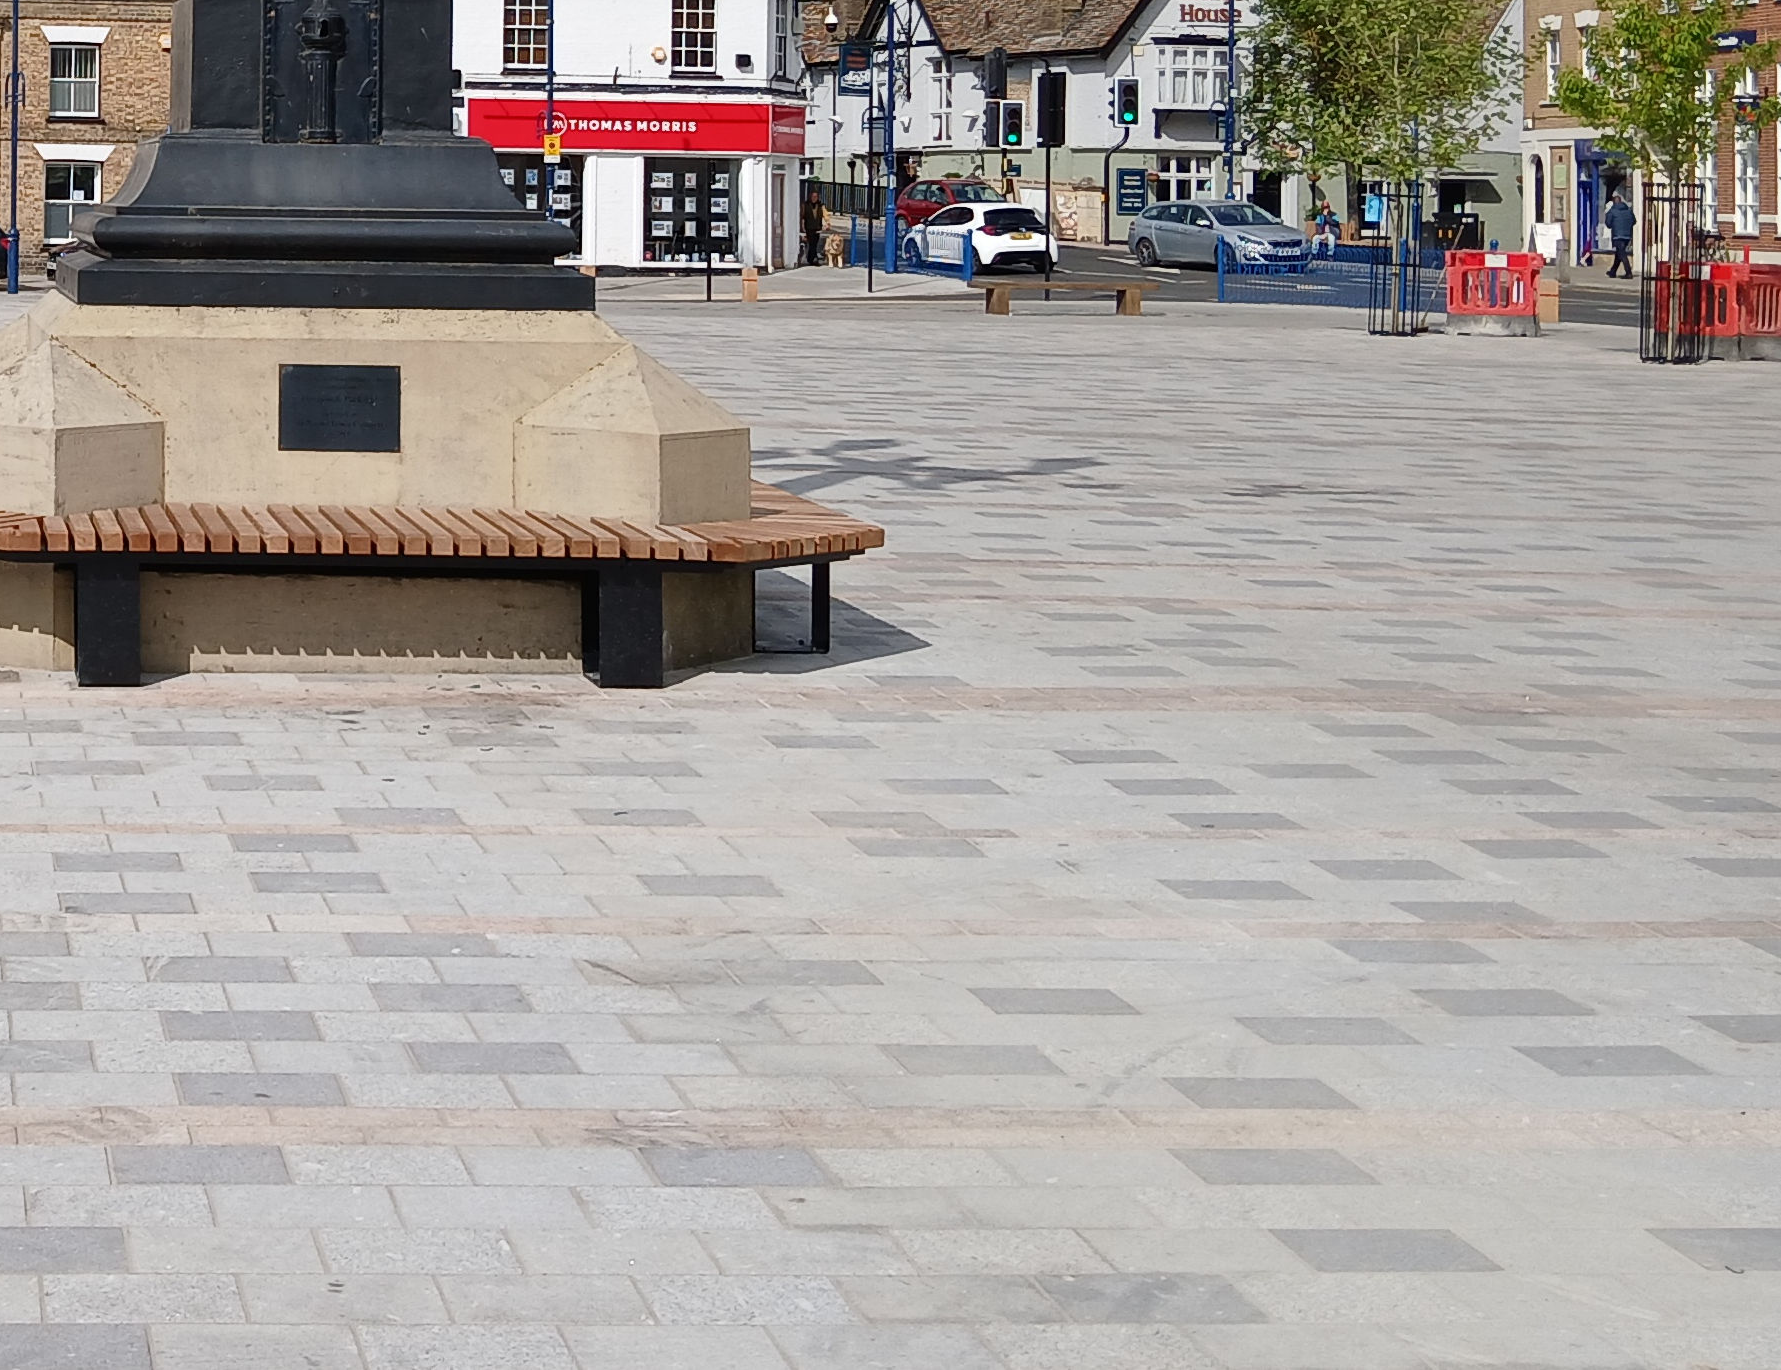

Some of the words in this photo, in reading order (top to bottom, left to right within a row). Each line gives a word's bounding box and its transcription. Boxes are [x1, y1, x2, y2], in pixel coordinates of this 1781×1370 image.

[1179, 4, 1242, 23] House
[568, 119, 632, 132] THOMAS
[636, 121, 697, 133] MORRIS
